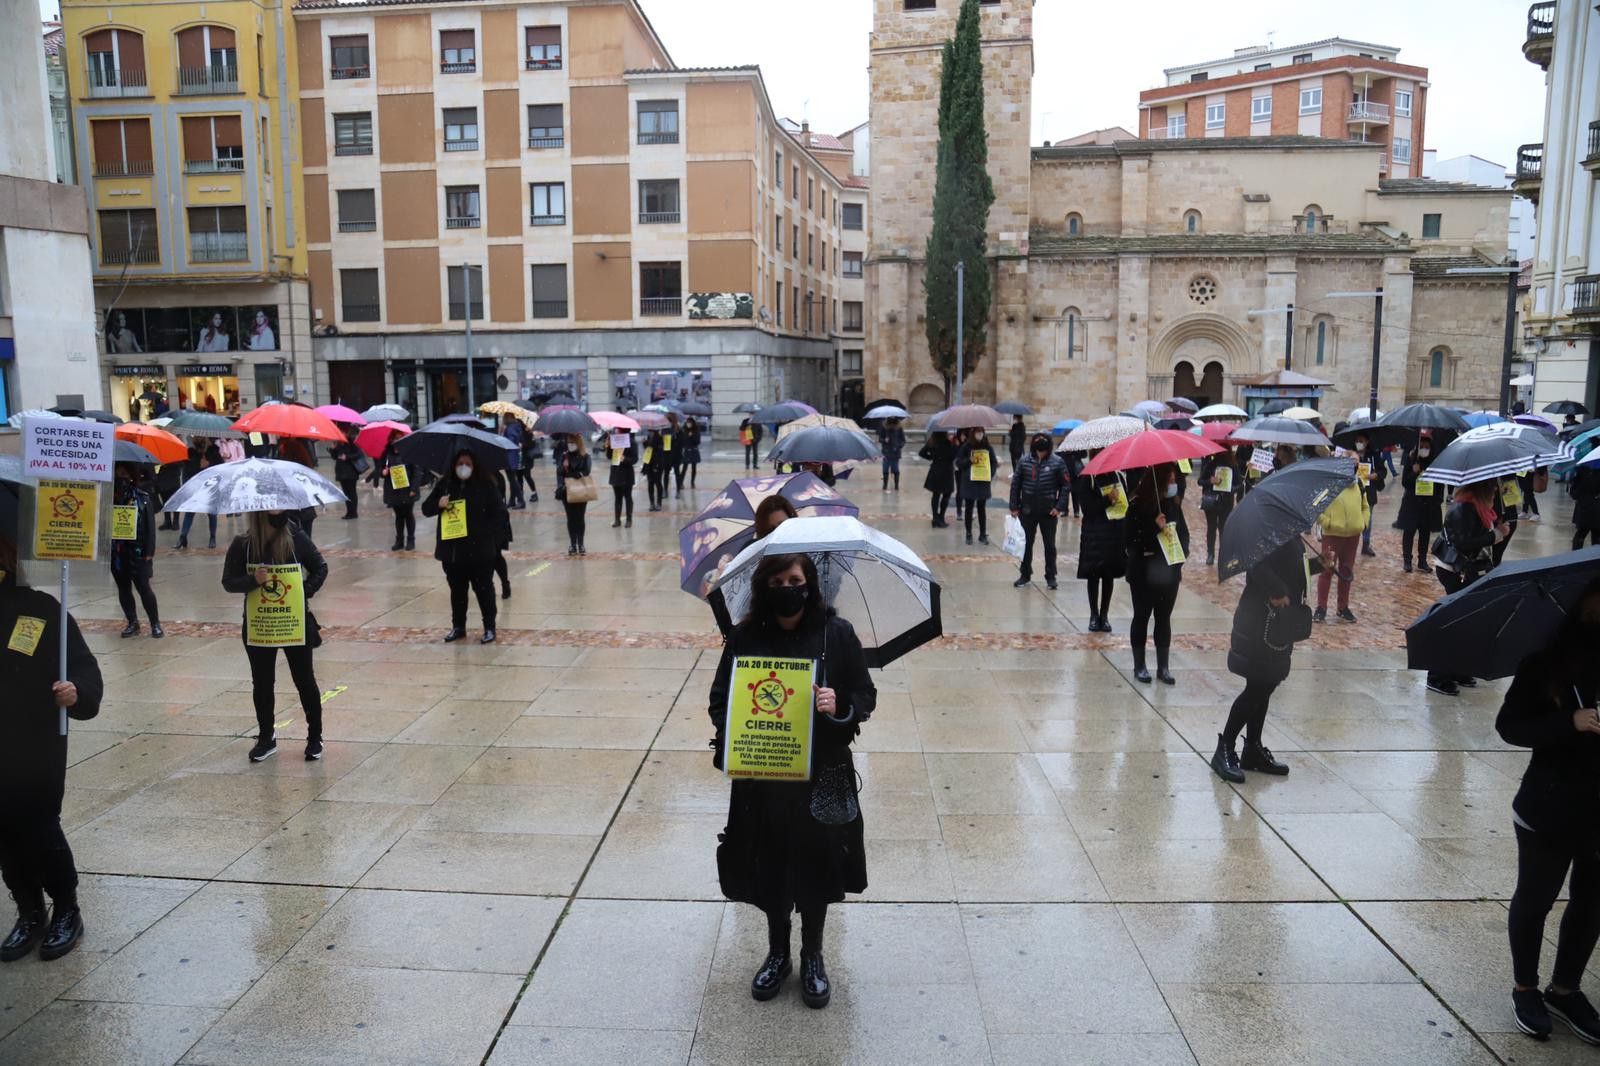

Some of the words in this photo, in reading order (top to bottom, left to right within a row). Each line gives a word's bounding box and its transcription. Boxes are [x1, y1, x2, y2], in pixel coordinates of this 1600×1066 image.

[34, 426, 90, 438] CORTARSE
[92, 431, 104, 440] EL
[36, 438, 64, 448] PELO
[66, 440, 78, 448] ES
[82, 441, 102, 450] UNA
[40, 448, 98, 460] NECESIDAD
[30, 460, 50, 468] ¡IVA
[52, 461, 66, 469] AL
[68, 462, 88, 471] 10%
[90, 463, 106, 472] YA!
[49, 520, 83, 529] CIERRE
[737, 660, 750, 668] DIA
[752, 660, 762, 669] 20
[763, 661, 773, 670] DE
[774, 662, 811, 672] OCTUBRE
[745, 720, 792, 732] CIERRE
